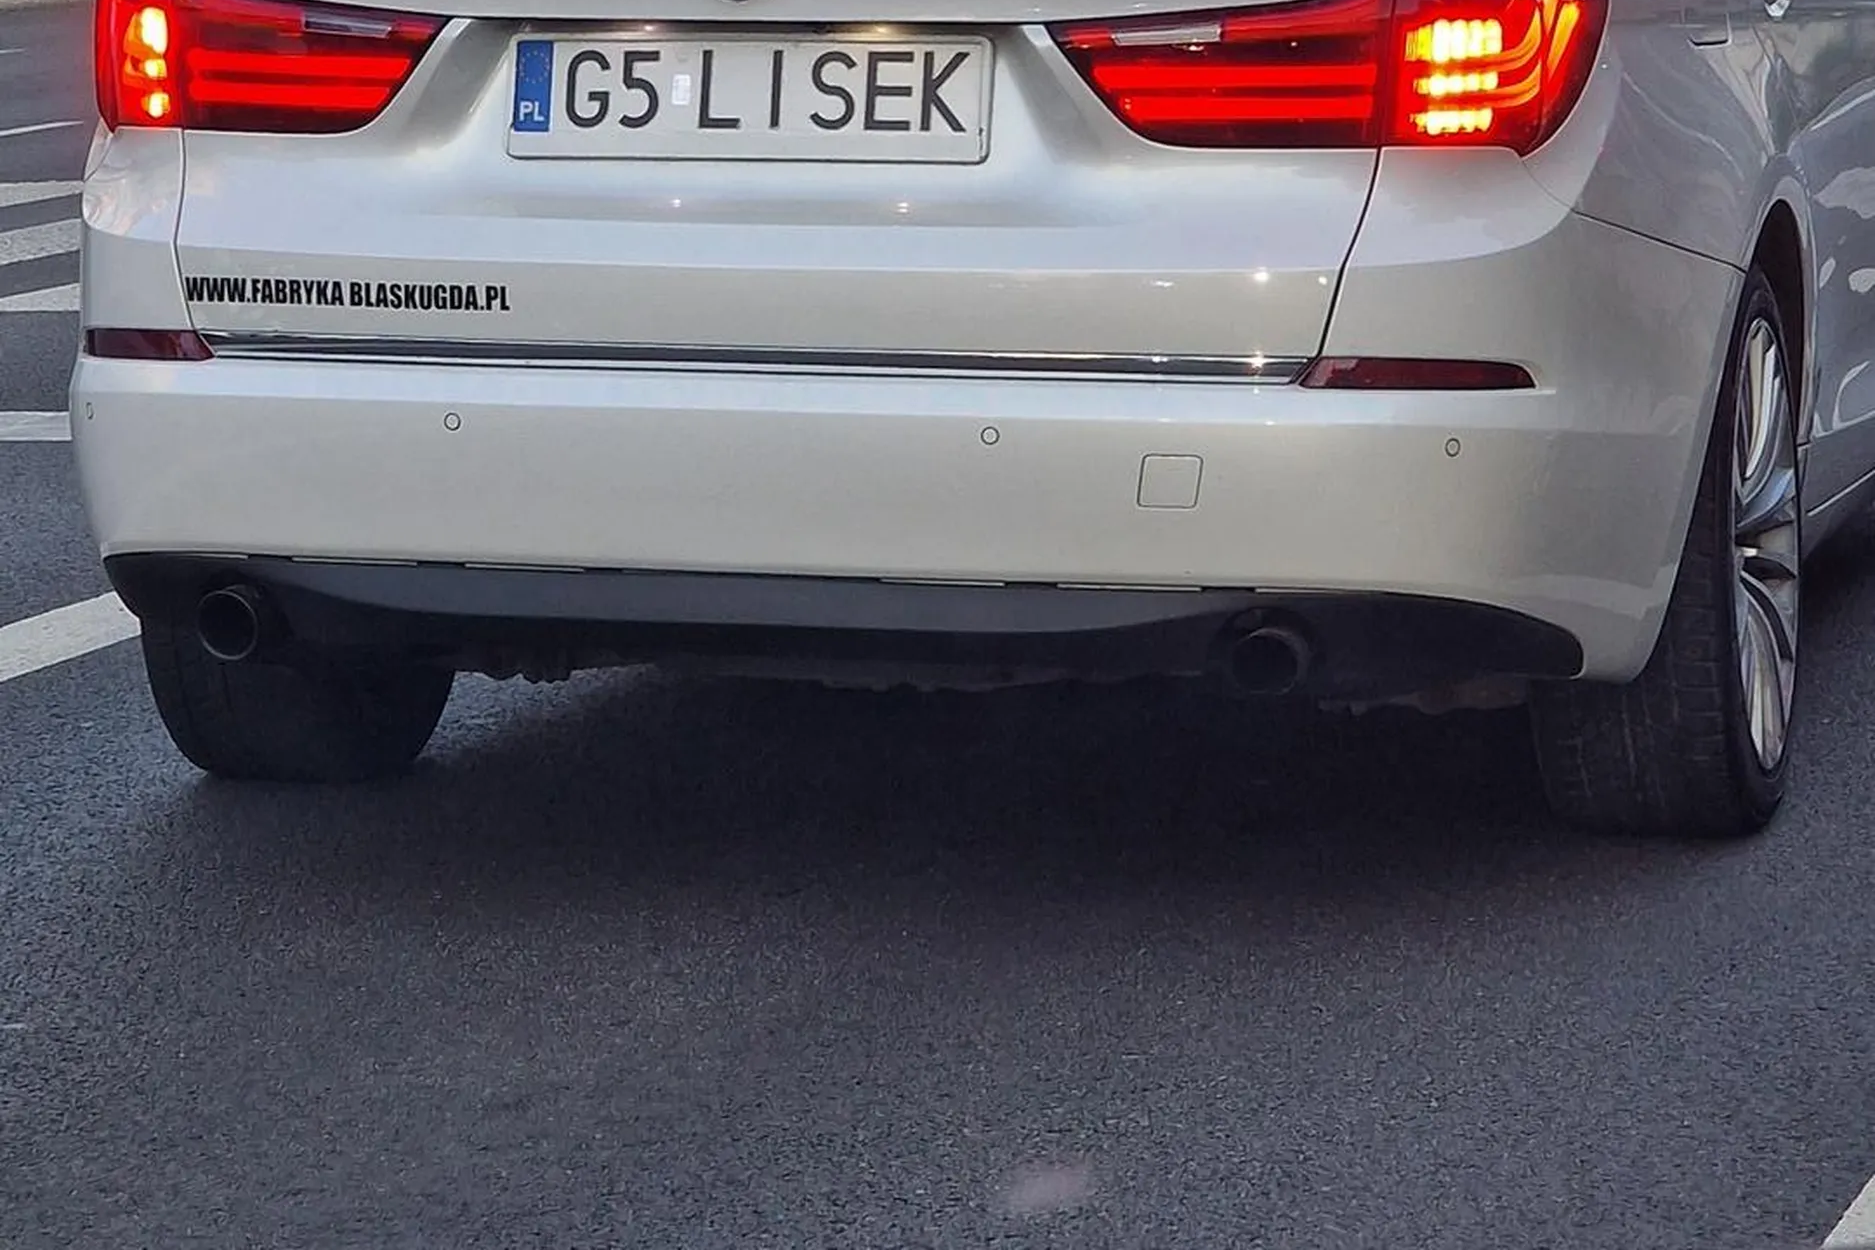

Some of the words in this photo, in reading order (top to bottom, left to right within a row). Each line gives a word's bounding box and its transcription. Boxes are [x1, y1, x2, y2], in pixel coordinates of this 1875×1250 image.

[519, 101, 544, 122] PL
[185, 276, 344, 306] WWW.FABRYKA
[350, 282, 510, 311] BLASKUGDA.PL
